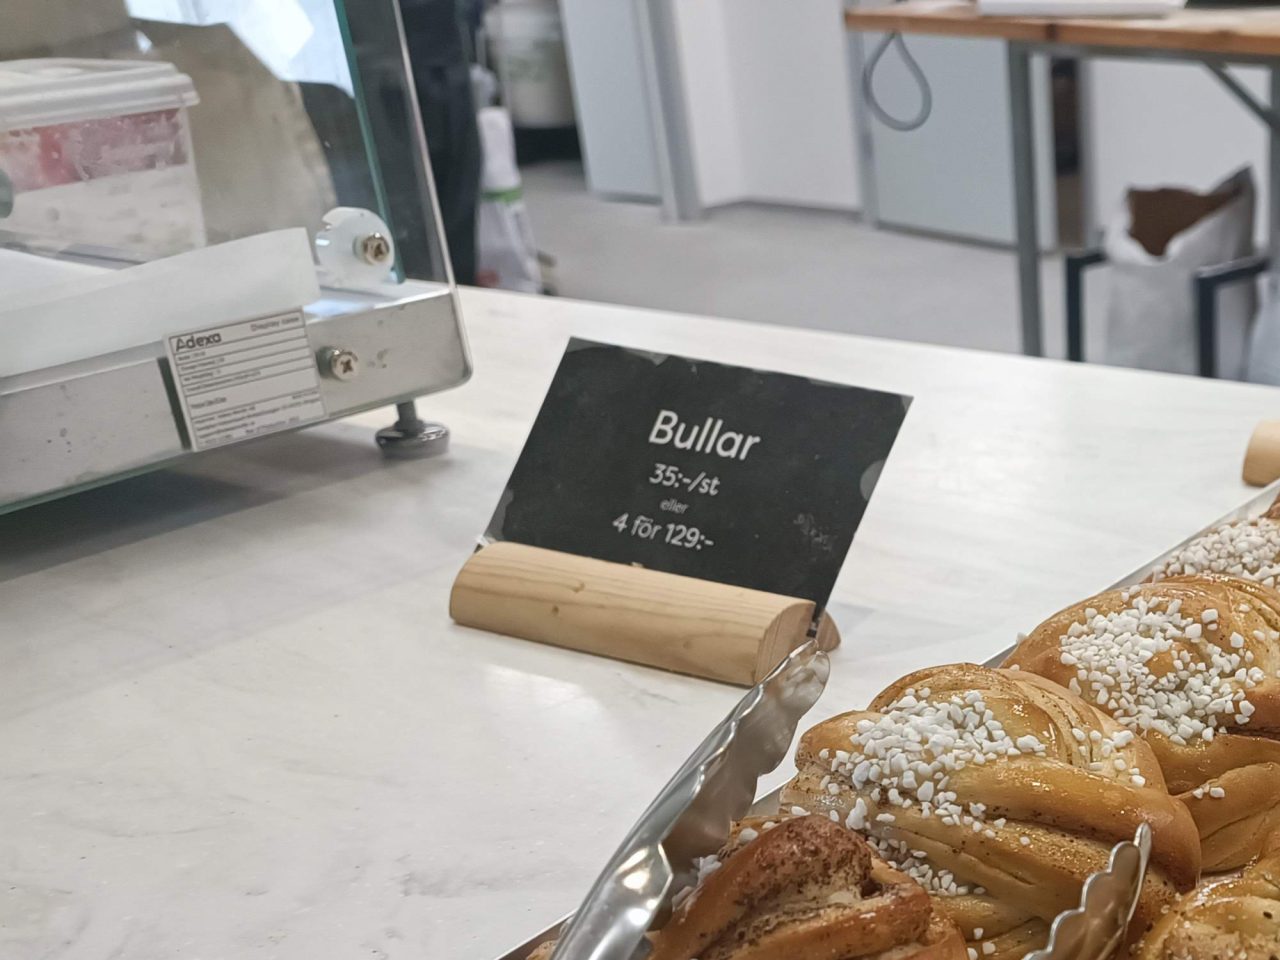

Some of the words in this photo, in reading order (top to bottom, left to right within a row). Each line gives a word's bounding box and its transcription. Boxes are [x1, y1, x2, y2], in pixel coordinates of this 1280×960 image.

[175, 333, 222, 352] Adexa
[648, 409, 761, 461] Bullar
[649, 463, 721, 496] 35:-/st
[660, 499, 690, 515] eller
[612, 512, 629, 532] 4
[631, 515, 662, 541] för
[665, 522, 714, 551] 129:-
